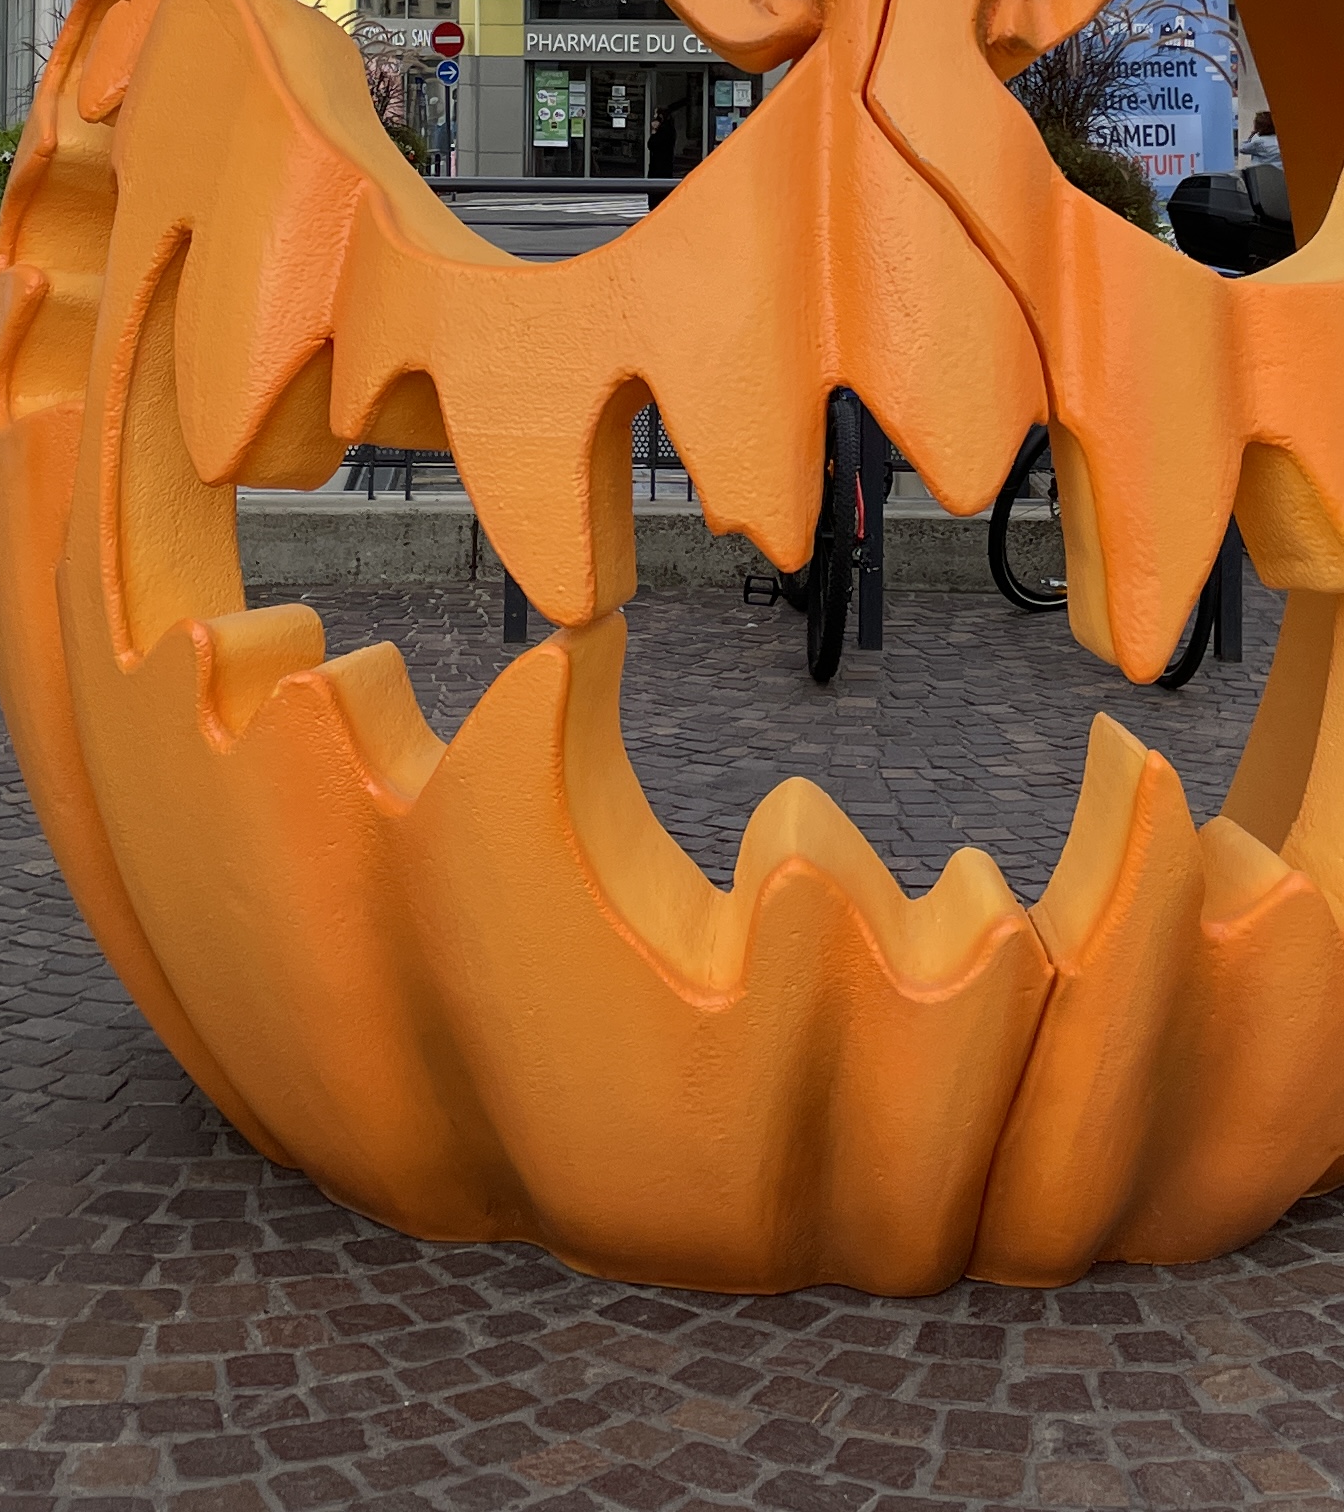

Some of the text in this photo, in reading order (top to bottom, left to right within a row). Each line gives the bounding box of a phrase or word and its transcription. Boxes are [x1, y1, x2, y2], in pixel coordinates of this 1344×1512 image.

[411, 29, 432, 47] SAN
[526, 33, 713, 53] PHARMACIE DU CE
[1096, 124, 1175, 148] SAMEDI
